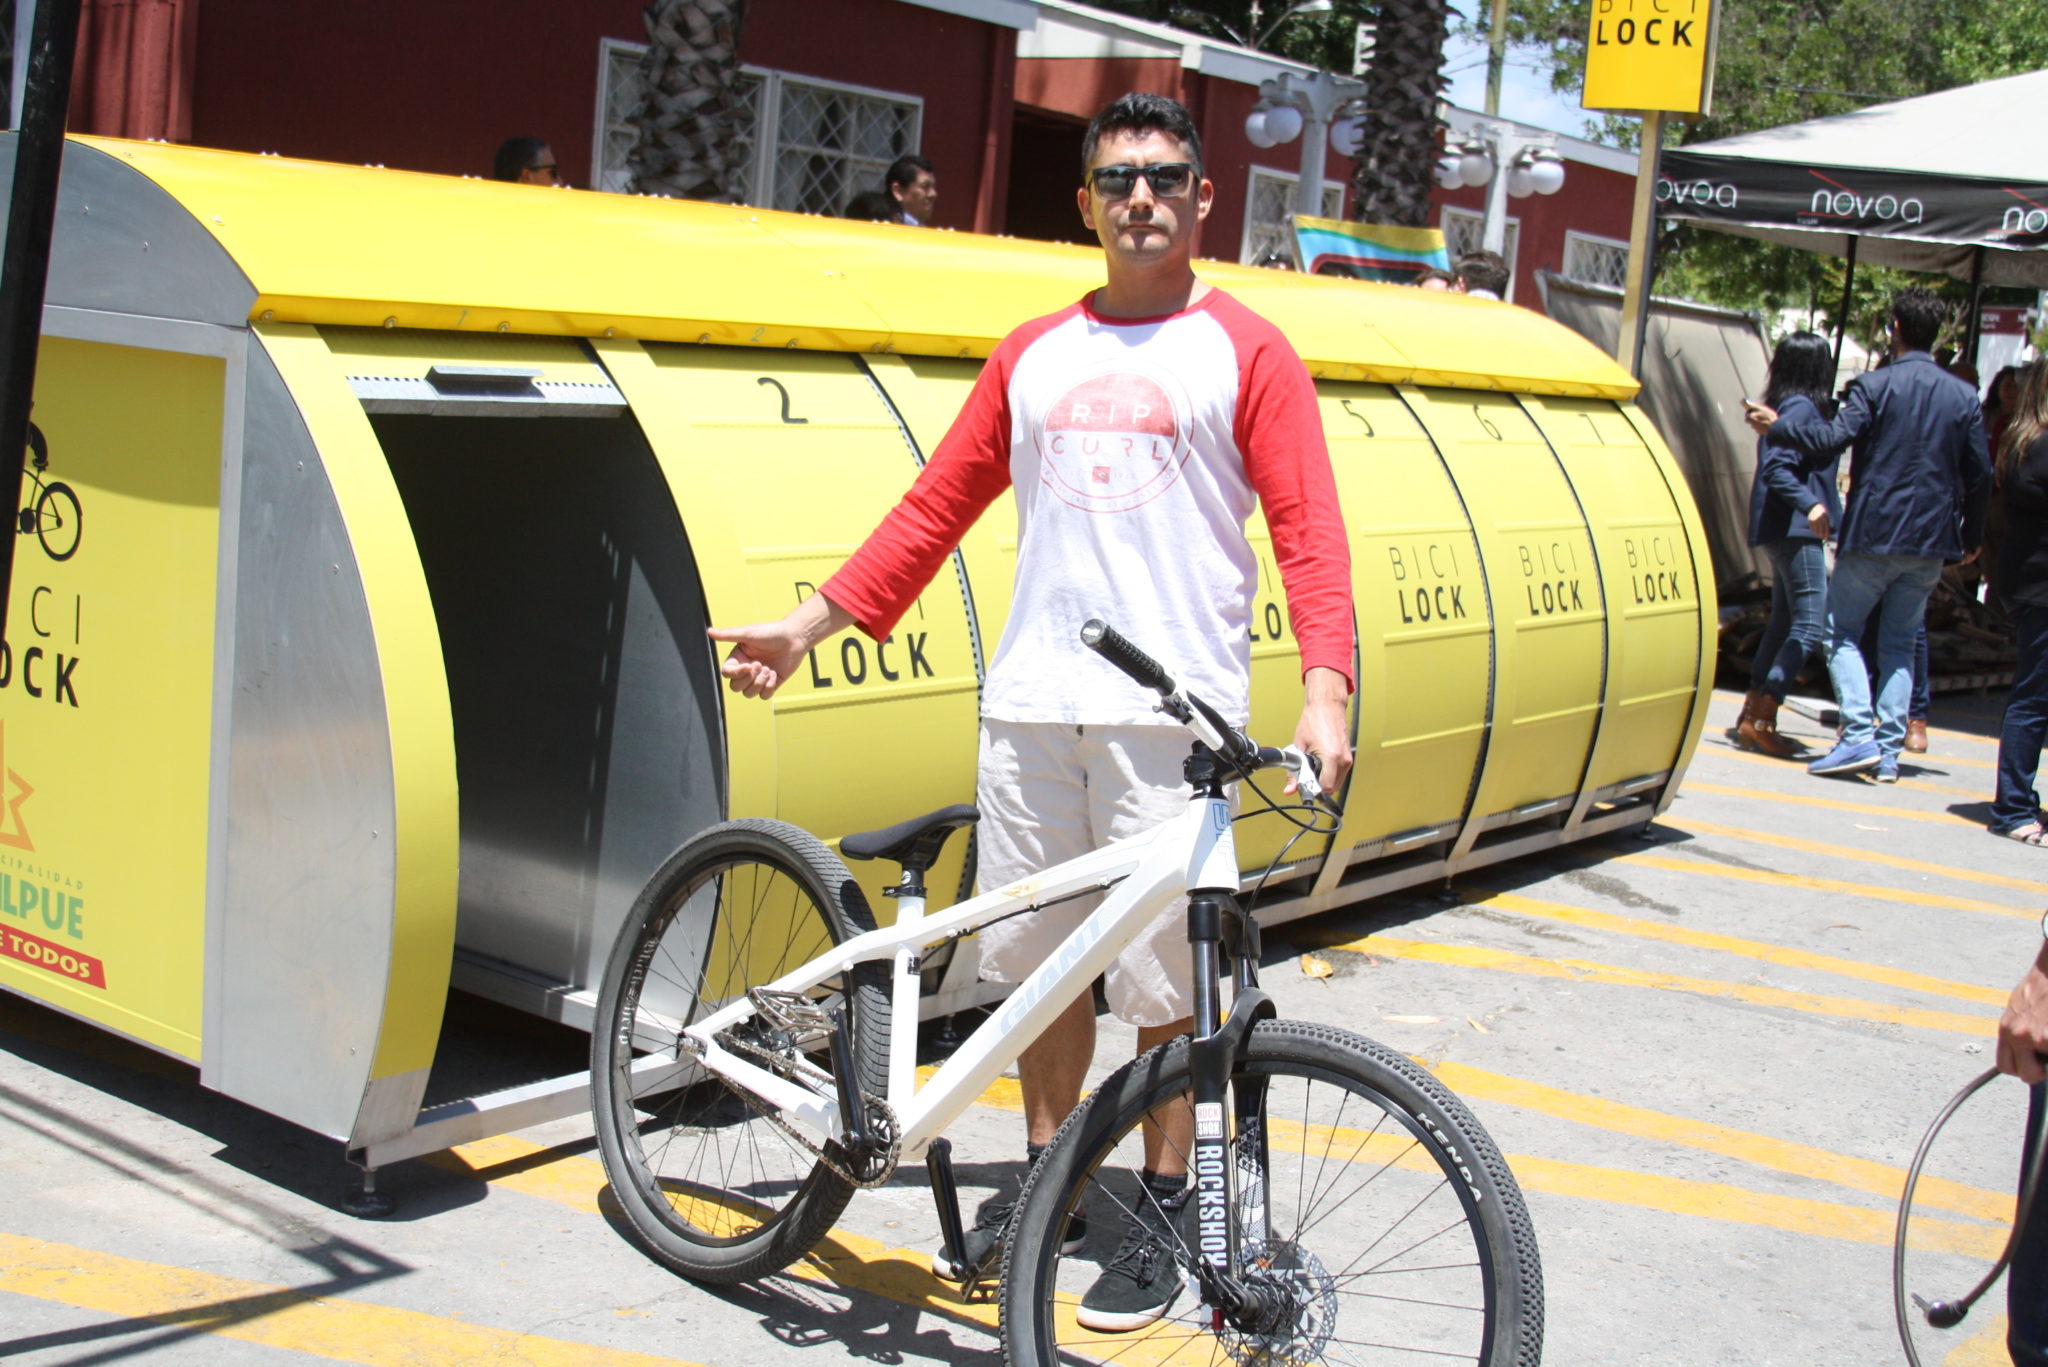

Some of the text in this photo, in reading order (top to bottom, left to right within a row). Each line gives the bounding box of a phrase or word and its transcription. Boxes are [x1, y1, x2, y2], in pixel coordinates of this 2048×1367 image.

[1597, 18, 1694, 47] LOCK
[1656, 178, 1738, 208] ovoa
[1811, 190, 1923, 223] novoa
[757, 377, 809, 424] 2
[1070, 403, 1151, 425] RIP
[1340, 399, 1375, 438] 5
[1472, 404, 1503, 441] 6
[1578, 413, 1605, 446] 7
[1050, 435, 1163, 461] CURL
[1388, 544, 1459, 581] BICI
[1519, 542, 1577, 577] BICI
[1624, 537, 1675, 568] BICI
[1398, 585, 1466, 623] LOCK
[1527, 580, 1583, 615] LOCK
[1632, 571, 1681, 604] LOCK
[31, 586, 80, 645] CI
[808, 632, 935, 689] LOCK
[8, 934, 91, 978] TODOS
[1000, 907, 1104, 1036] GIANT
[1197, 1106, 1219, 1119] ROCK
[1416, 1112, 1482, 1202] KENDA
